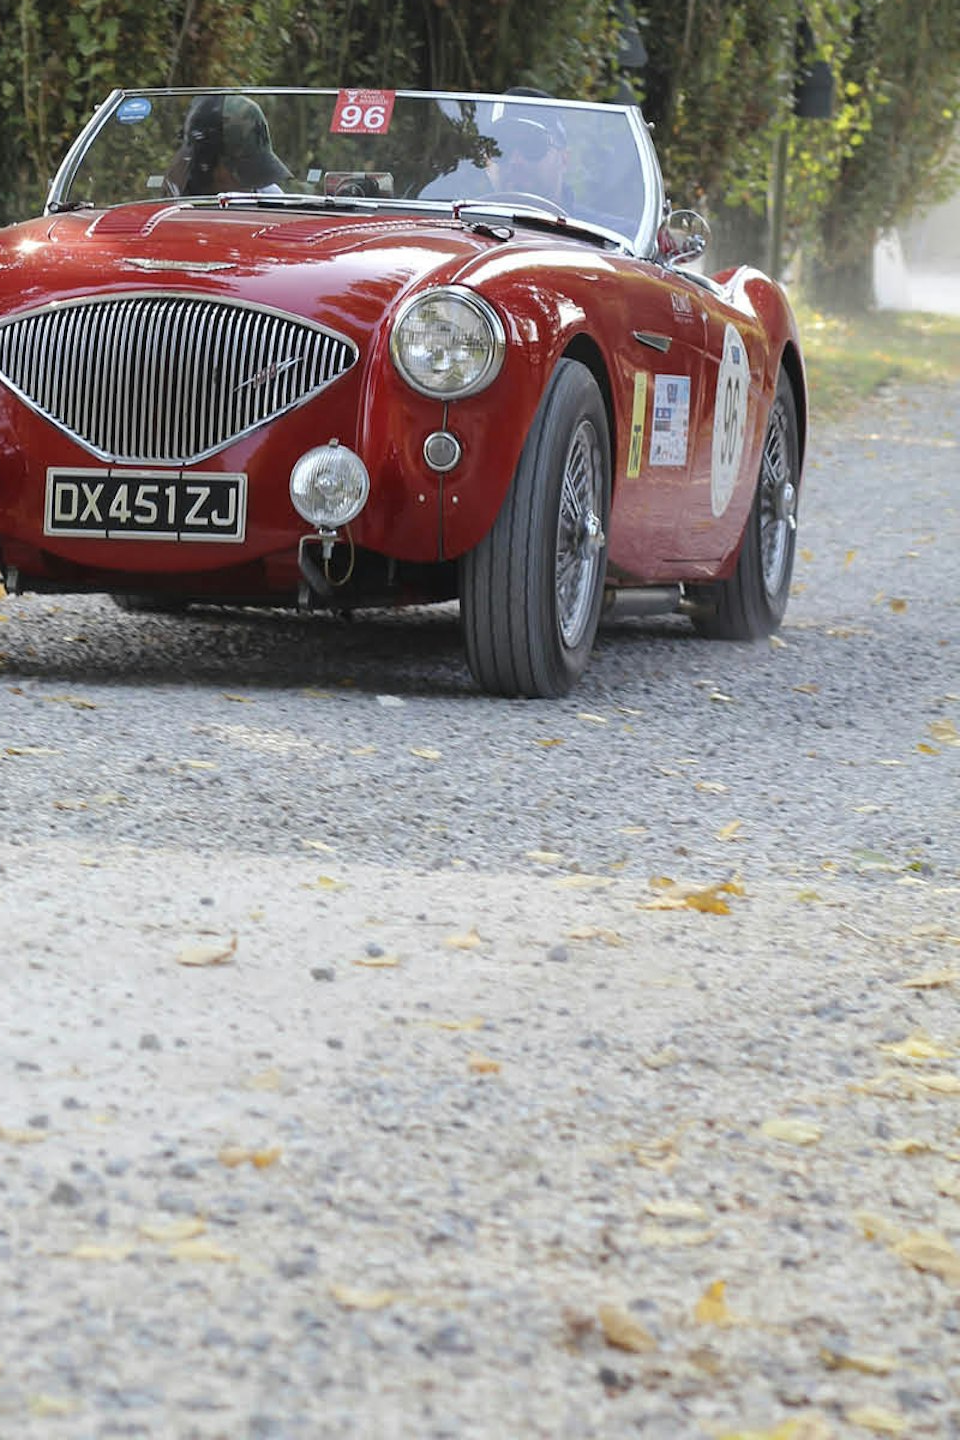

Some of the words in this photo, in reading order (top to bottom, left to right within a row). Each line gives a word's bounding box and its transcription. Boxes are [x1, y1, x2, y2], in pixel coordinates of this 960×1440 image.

[340, 105, 385, 129] 96
[721, 376, 740, 465] 96
[54, 482, 236, 527] DX451ZJ
